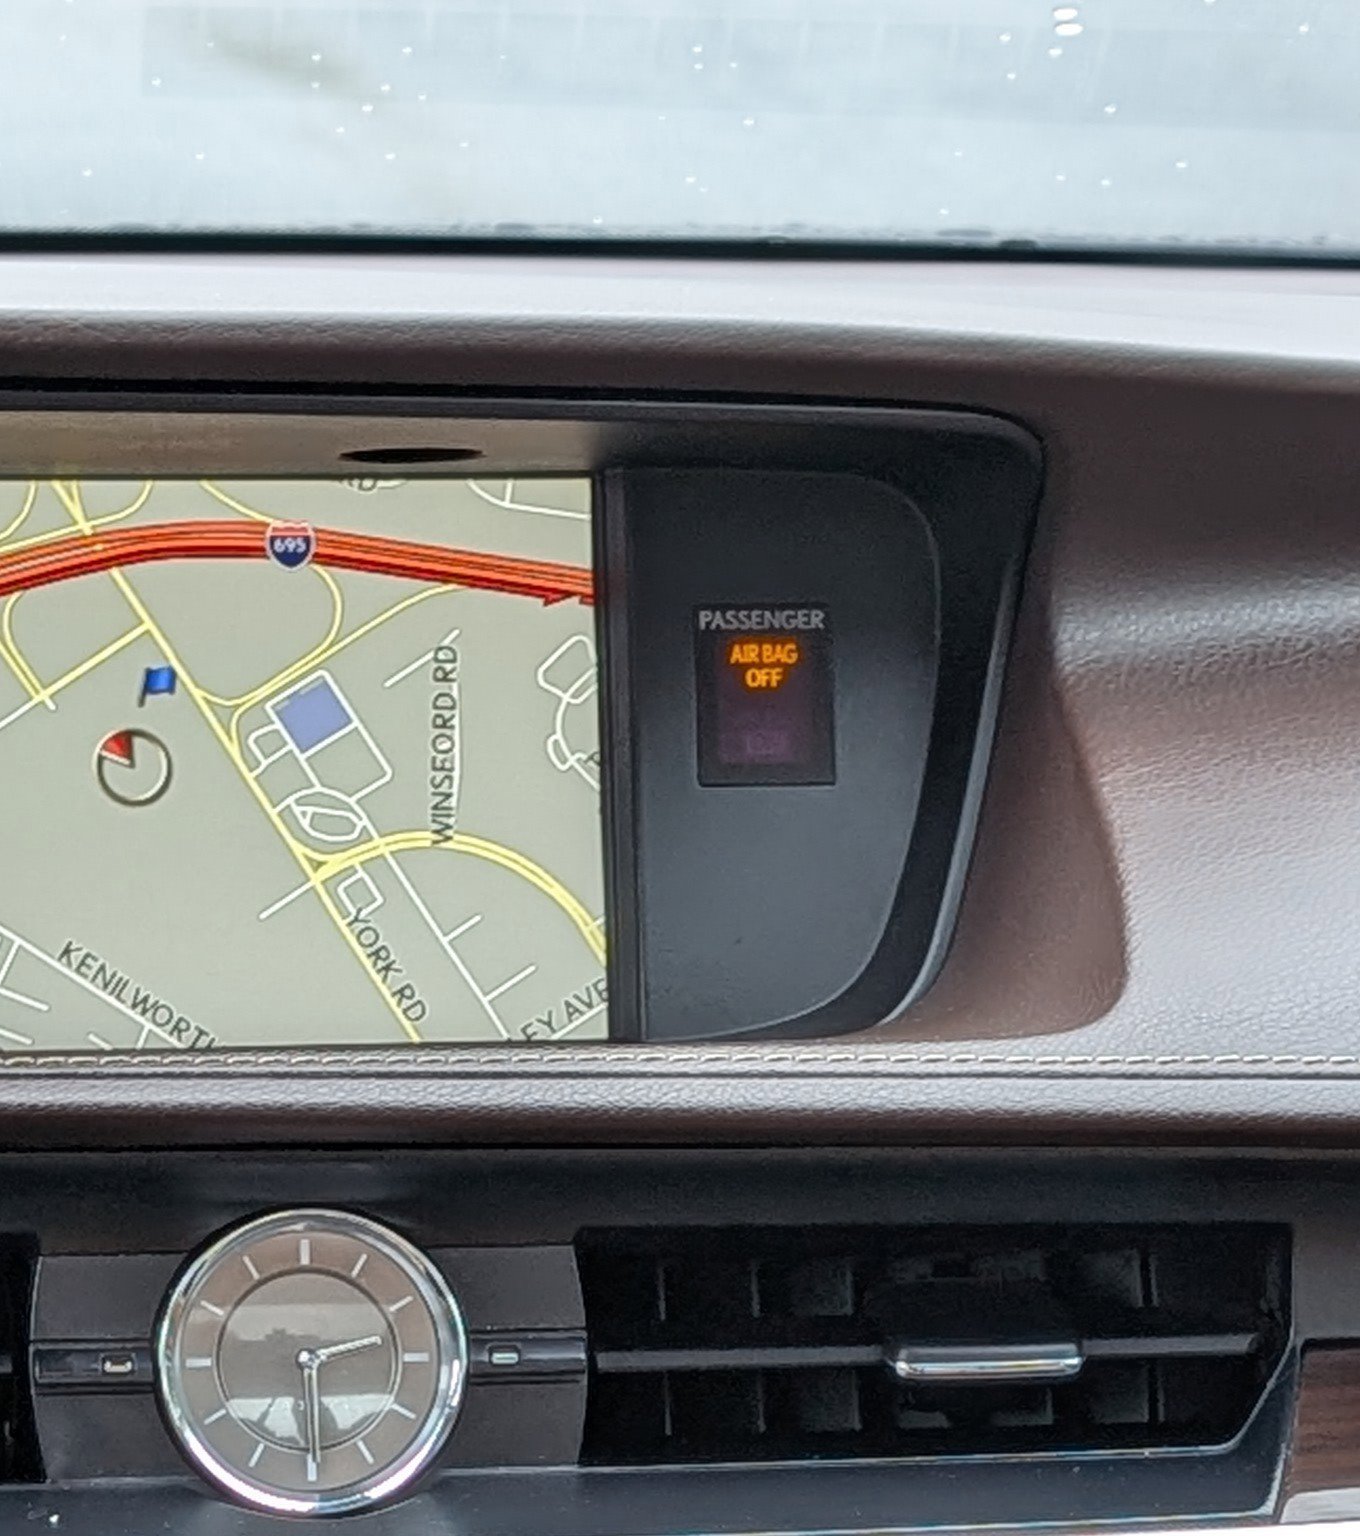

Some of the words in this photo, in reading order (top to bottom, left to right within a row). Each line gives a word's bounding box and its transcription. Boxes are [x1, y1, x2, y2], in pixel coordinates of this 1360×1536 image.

[273, 536, 307, 553] 695
[698, 609, 826, 631] PASSENGER
[432, 644, 459, 684] RD
[729, 643, 760, 665] AIR
[762, 643, 799, 665] BAG
[744, 667, 784, 688] OFF
[345, 906, 404, 984] YORK
[390, 982, 427, 1022] RD
[57, 940, 226, 1050] KENILWORT
[563, 977, 609, 1023] AVE
